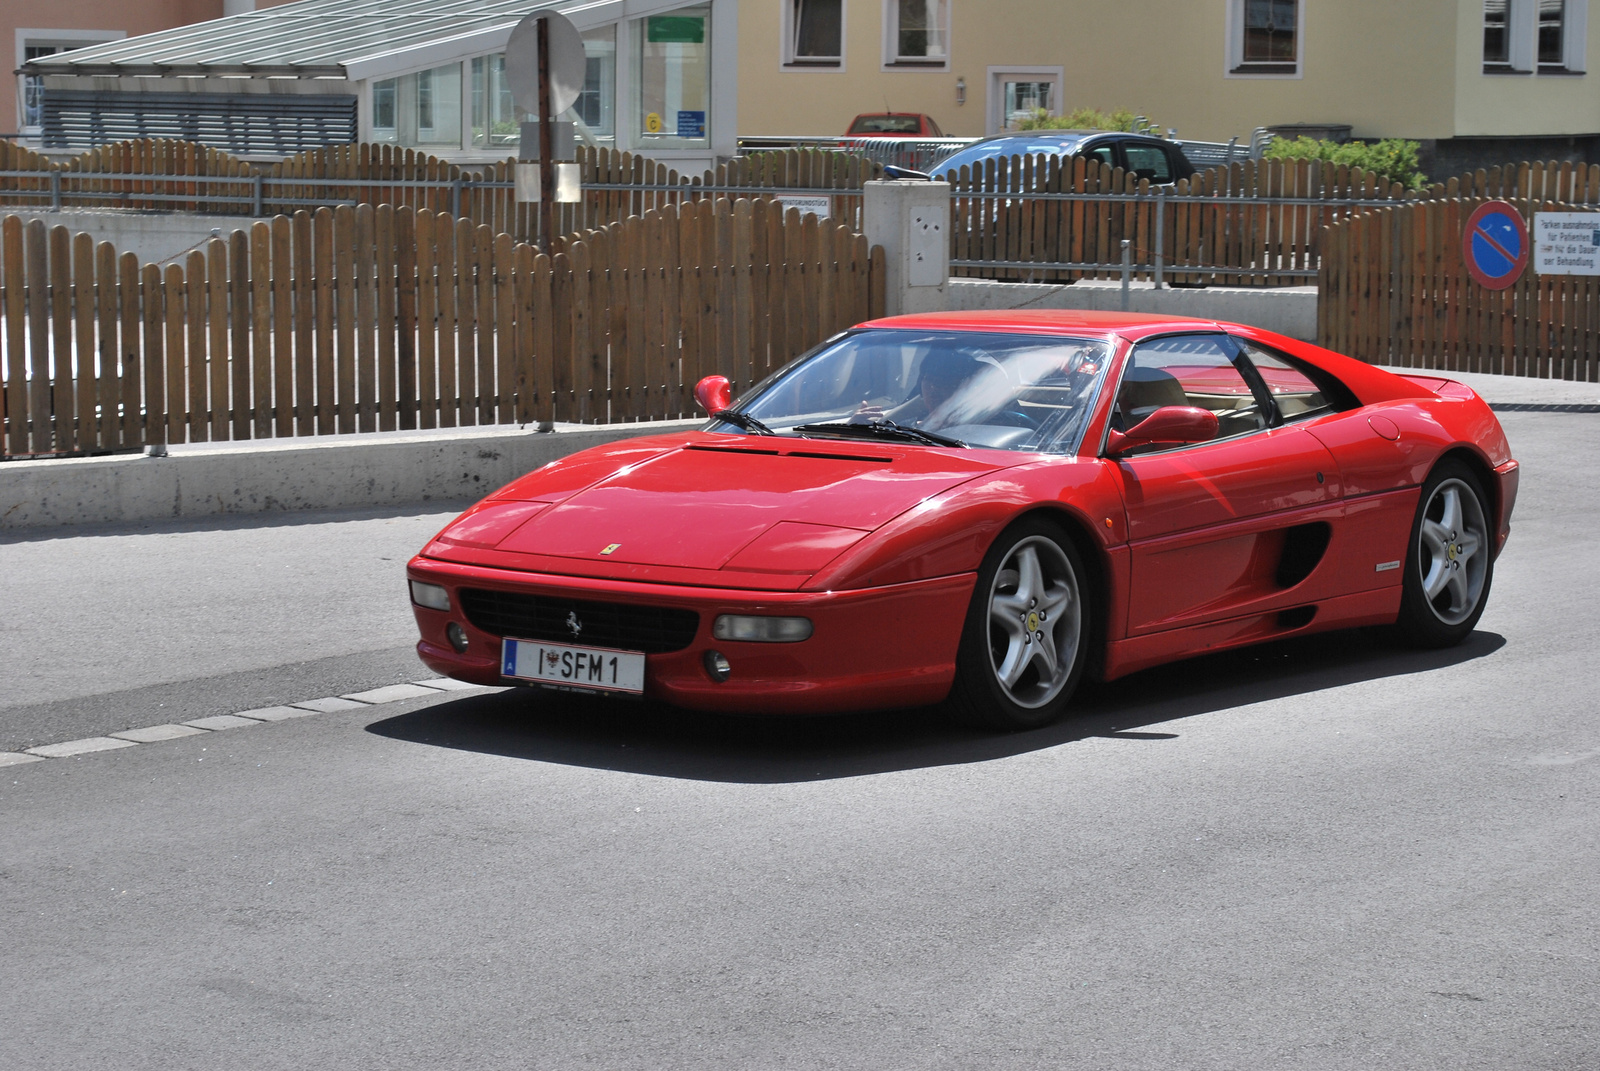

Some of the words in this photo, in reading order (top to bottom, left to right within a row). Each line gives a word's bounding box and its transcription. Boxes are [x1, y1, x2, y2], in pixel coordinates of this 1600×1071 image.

[1548, 232, 1557, 241] für
[1567, 244, 1576, 254] die
[1579, 244, 1598, 254] Dauer
[507, 662, 513, 670] A
[561, 650, 603, 682] SFM
[609, 656, 618, 684] 1
